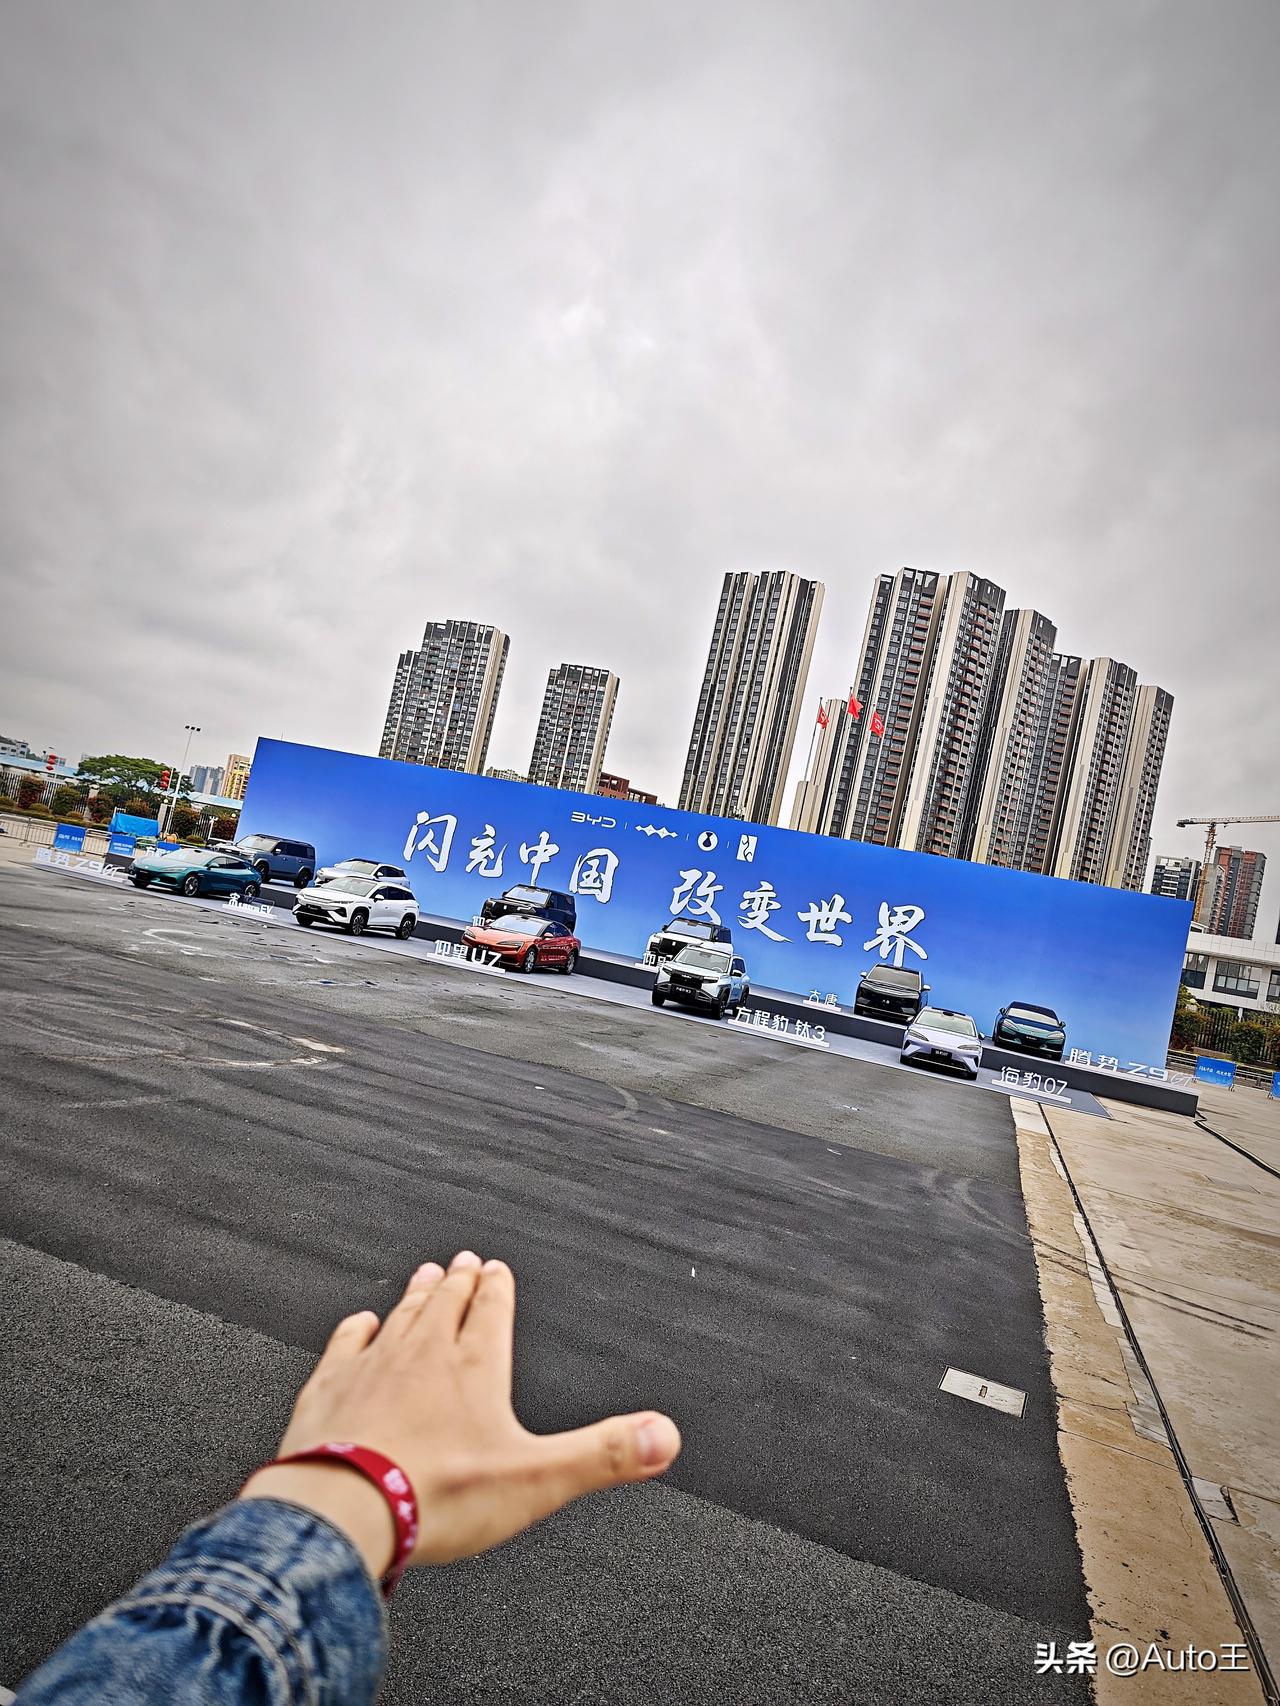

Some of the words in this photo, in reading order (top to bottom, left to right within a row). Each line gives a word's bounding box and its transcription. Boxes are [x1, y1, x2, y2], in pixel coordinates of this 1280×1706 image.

[571, 811, 616, 828] BYD
[403, 811, 620, 904] 闪充中国
[669, 868, 928, 967] 改变世界
[435, 939, 468, 960] 仰望
[470, 948, 503, 968] U7
[735, 1006, 789, 1034] 方程豹
[794, 1019, 826, 1042] 钛3
